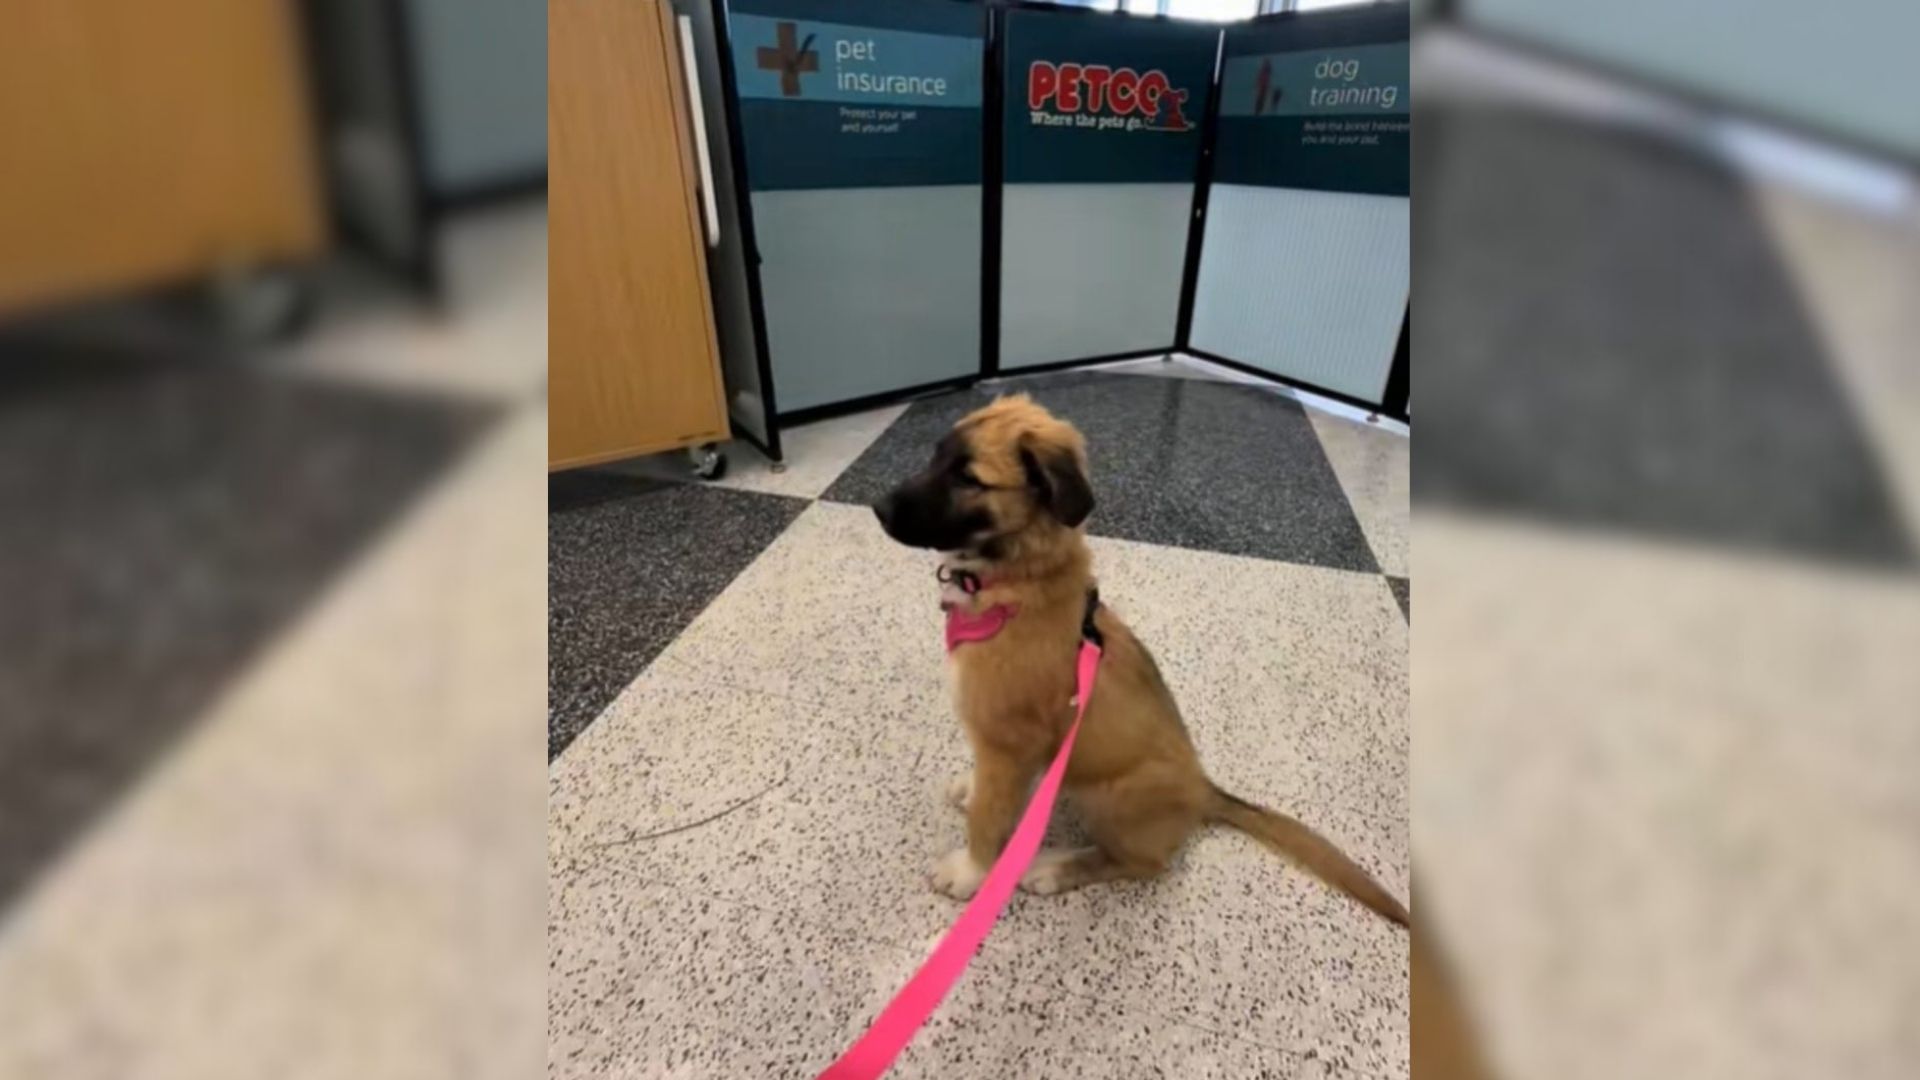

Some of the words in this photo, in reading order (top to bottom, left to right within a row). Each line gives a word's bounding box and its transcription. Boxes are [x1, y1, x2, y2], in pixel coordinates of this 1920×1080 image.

[835, 39, 876, 62] pet
[1314, 55, 1360, 82] dog
[836, 67, 947, 96] insurance
[1029, 60, 1171, 117] PETCO
[1309, 82, 1398, 109] training
[840, 107, 876, 120] Protect
[878, 111, 898, 121] your
[1031, 111, 1073, 126] Where
[1075, 113, 1096, 127] the
[1098, 116, 1125, 131] pets
[841, 123, 860, 132] and
